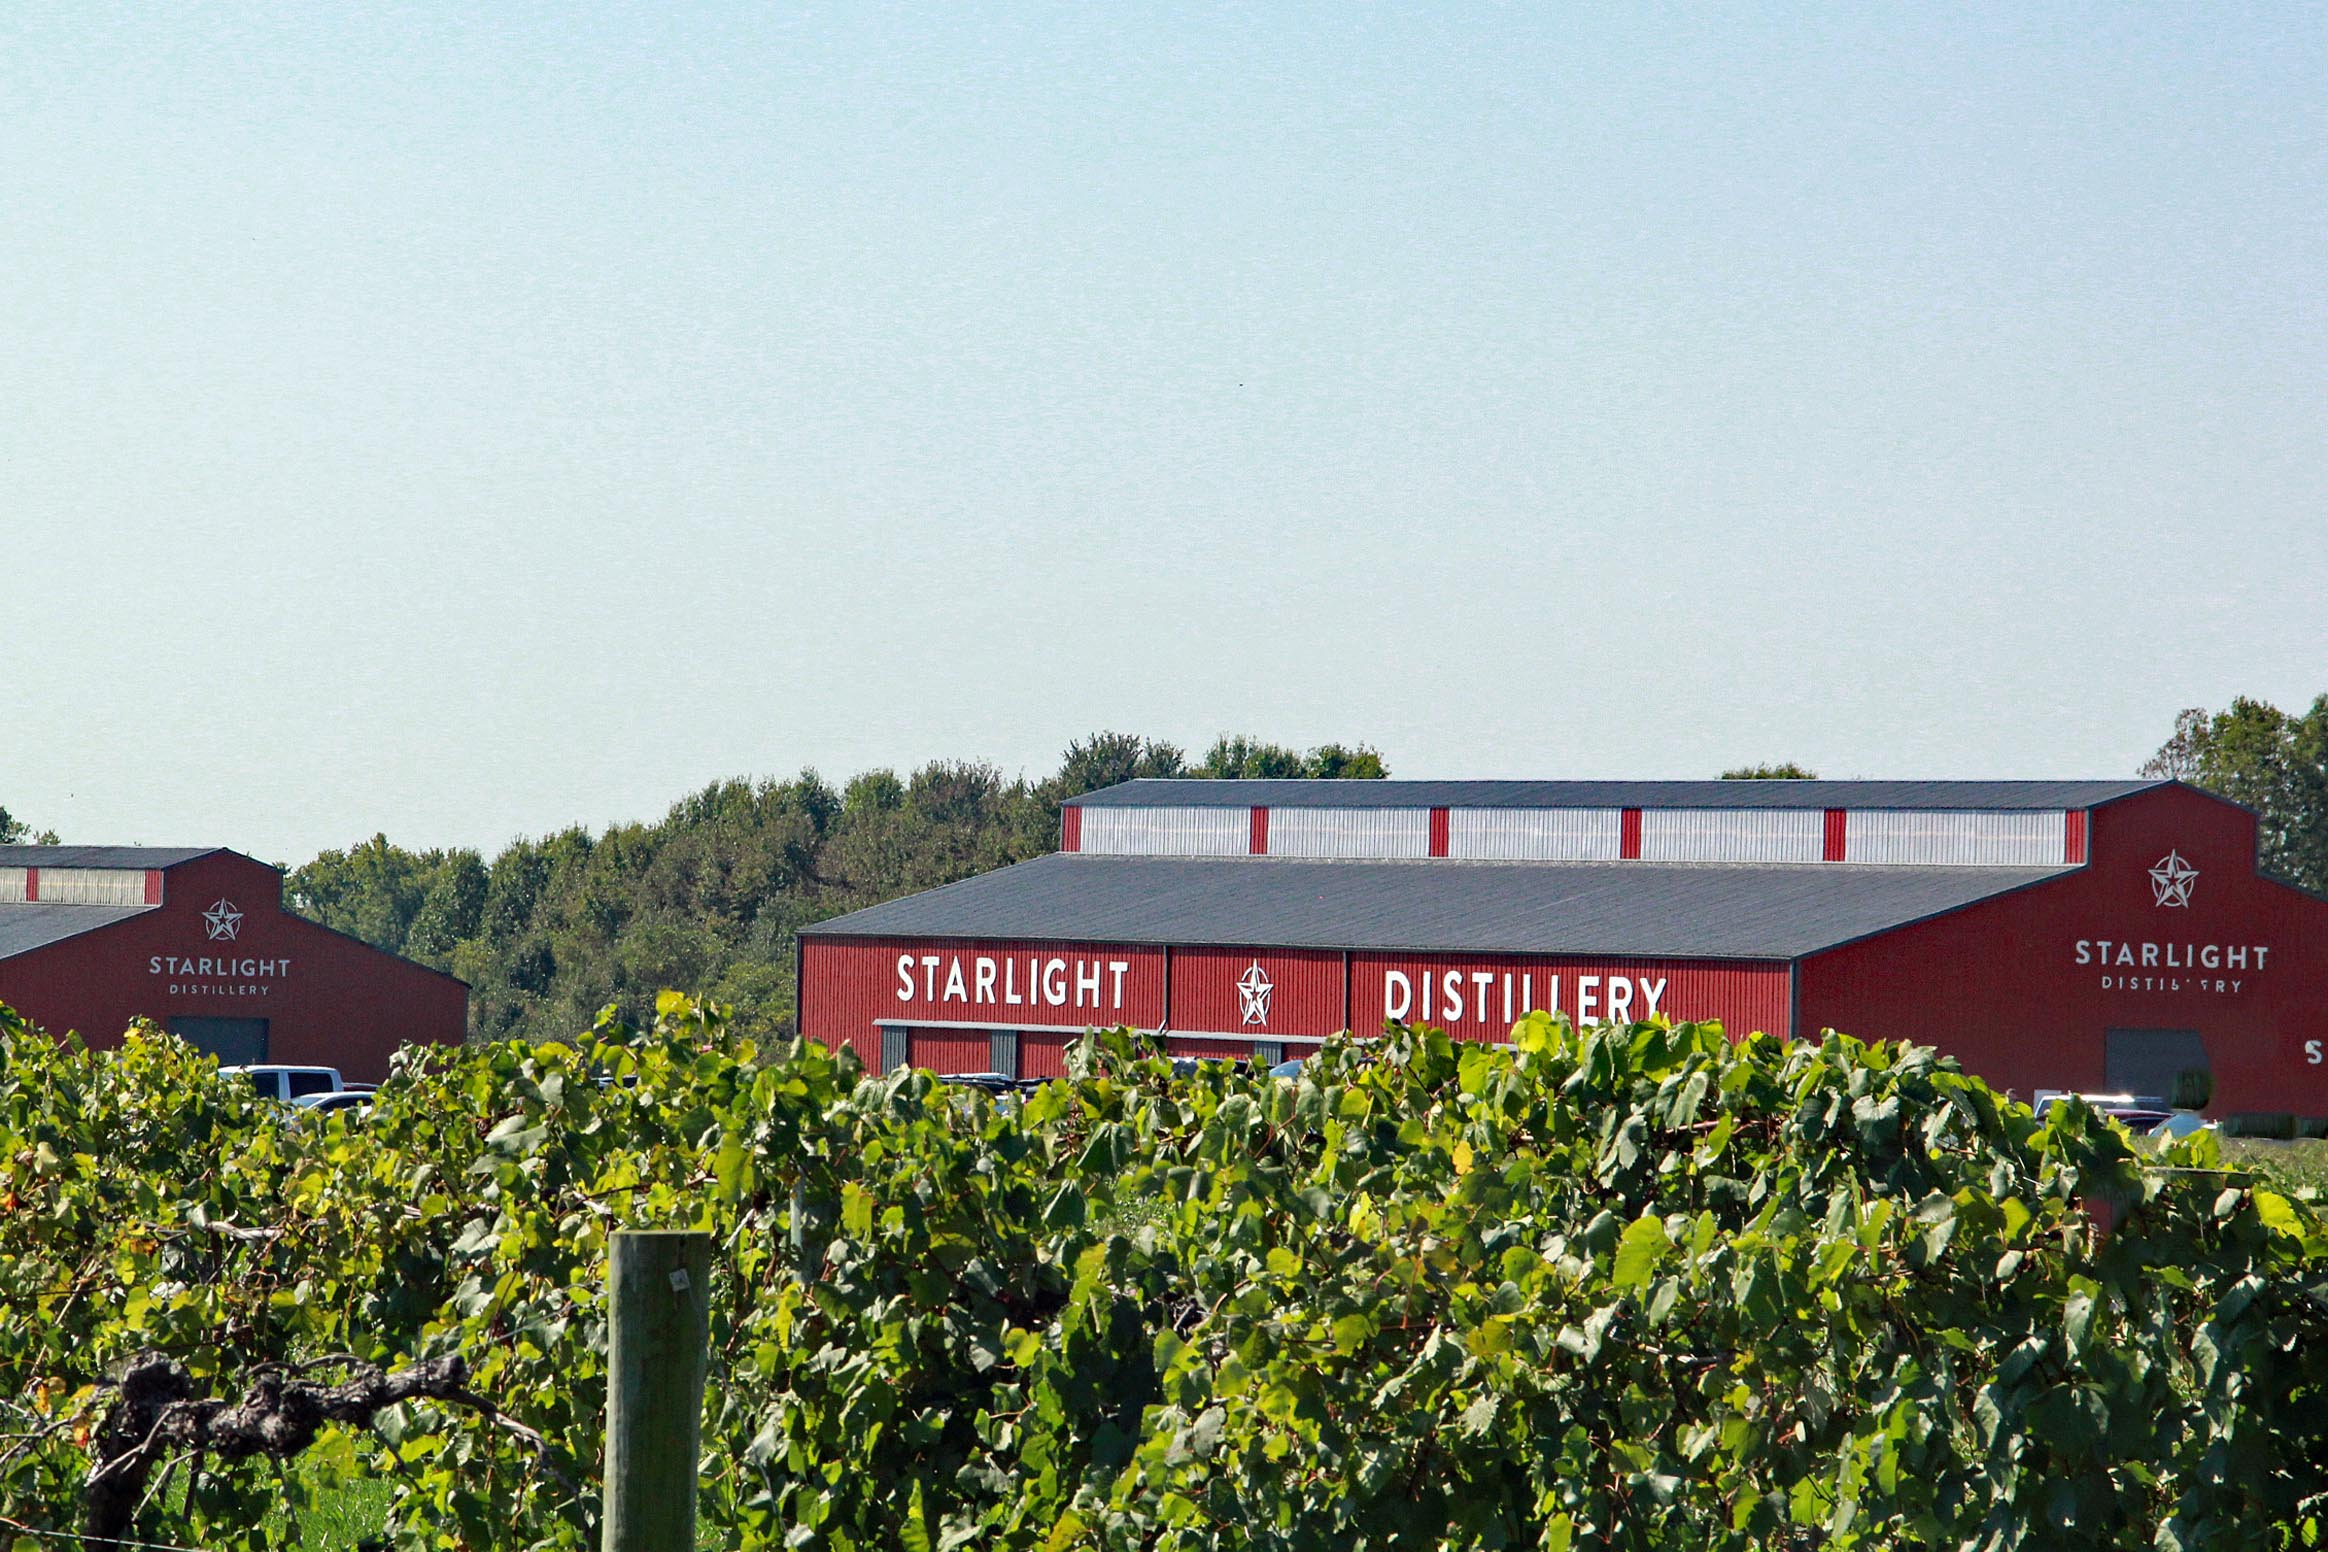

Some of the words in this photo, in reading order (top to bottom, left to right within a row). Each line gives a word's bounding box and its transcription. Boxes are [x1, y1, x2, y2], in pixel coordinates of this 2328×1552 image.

[2075, 939, 2270, 969] STARLIGHT
[149, 956, 291, 977] STARLIGHT
[169, 984, 270, 996] DISTILLERY
[896, 954, 1130, 1009] STARLIGHT
[2102, 976, 2242, 993] DISTILRY
